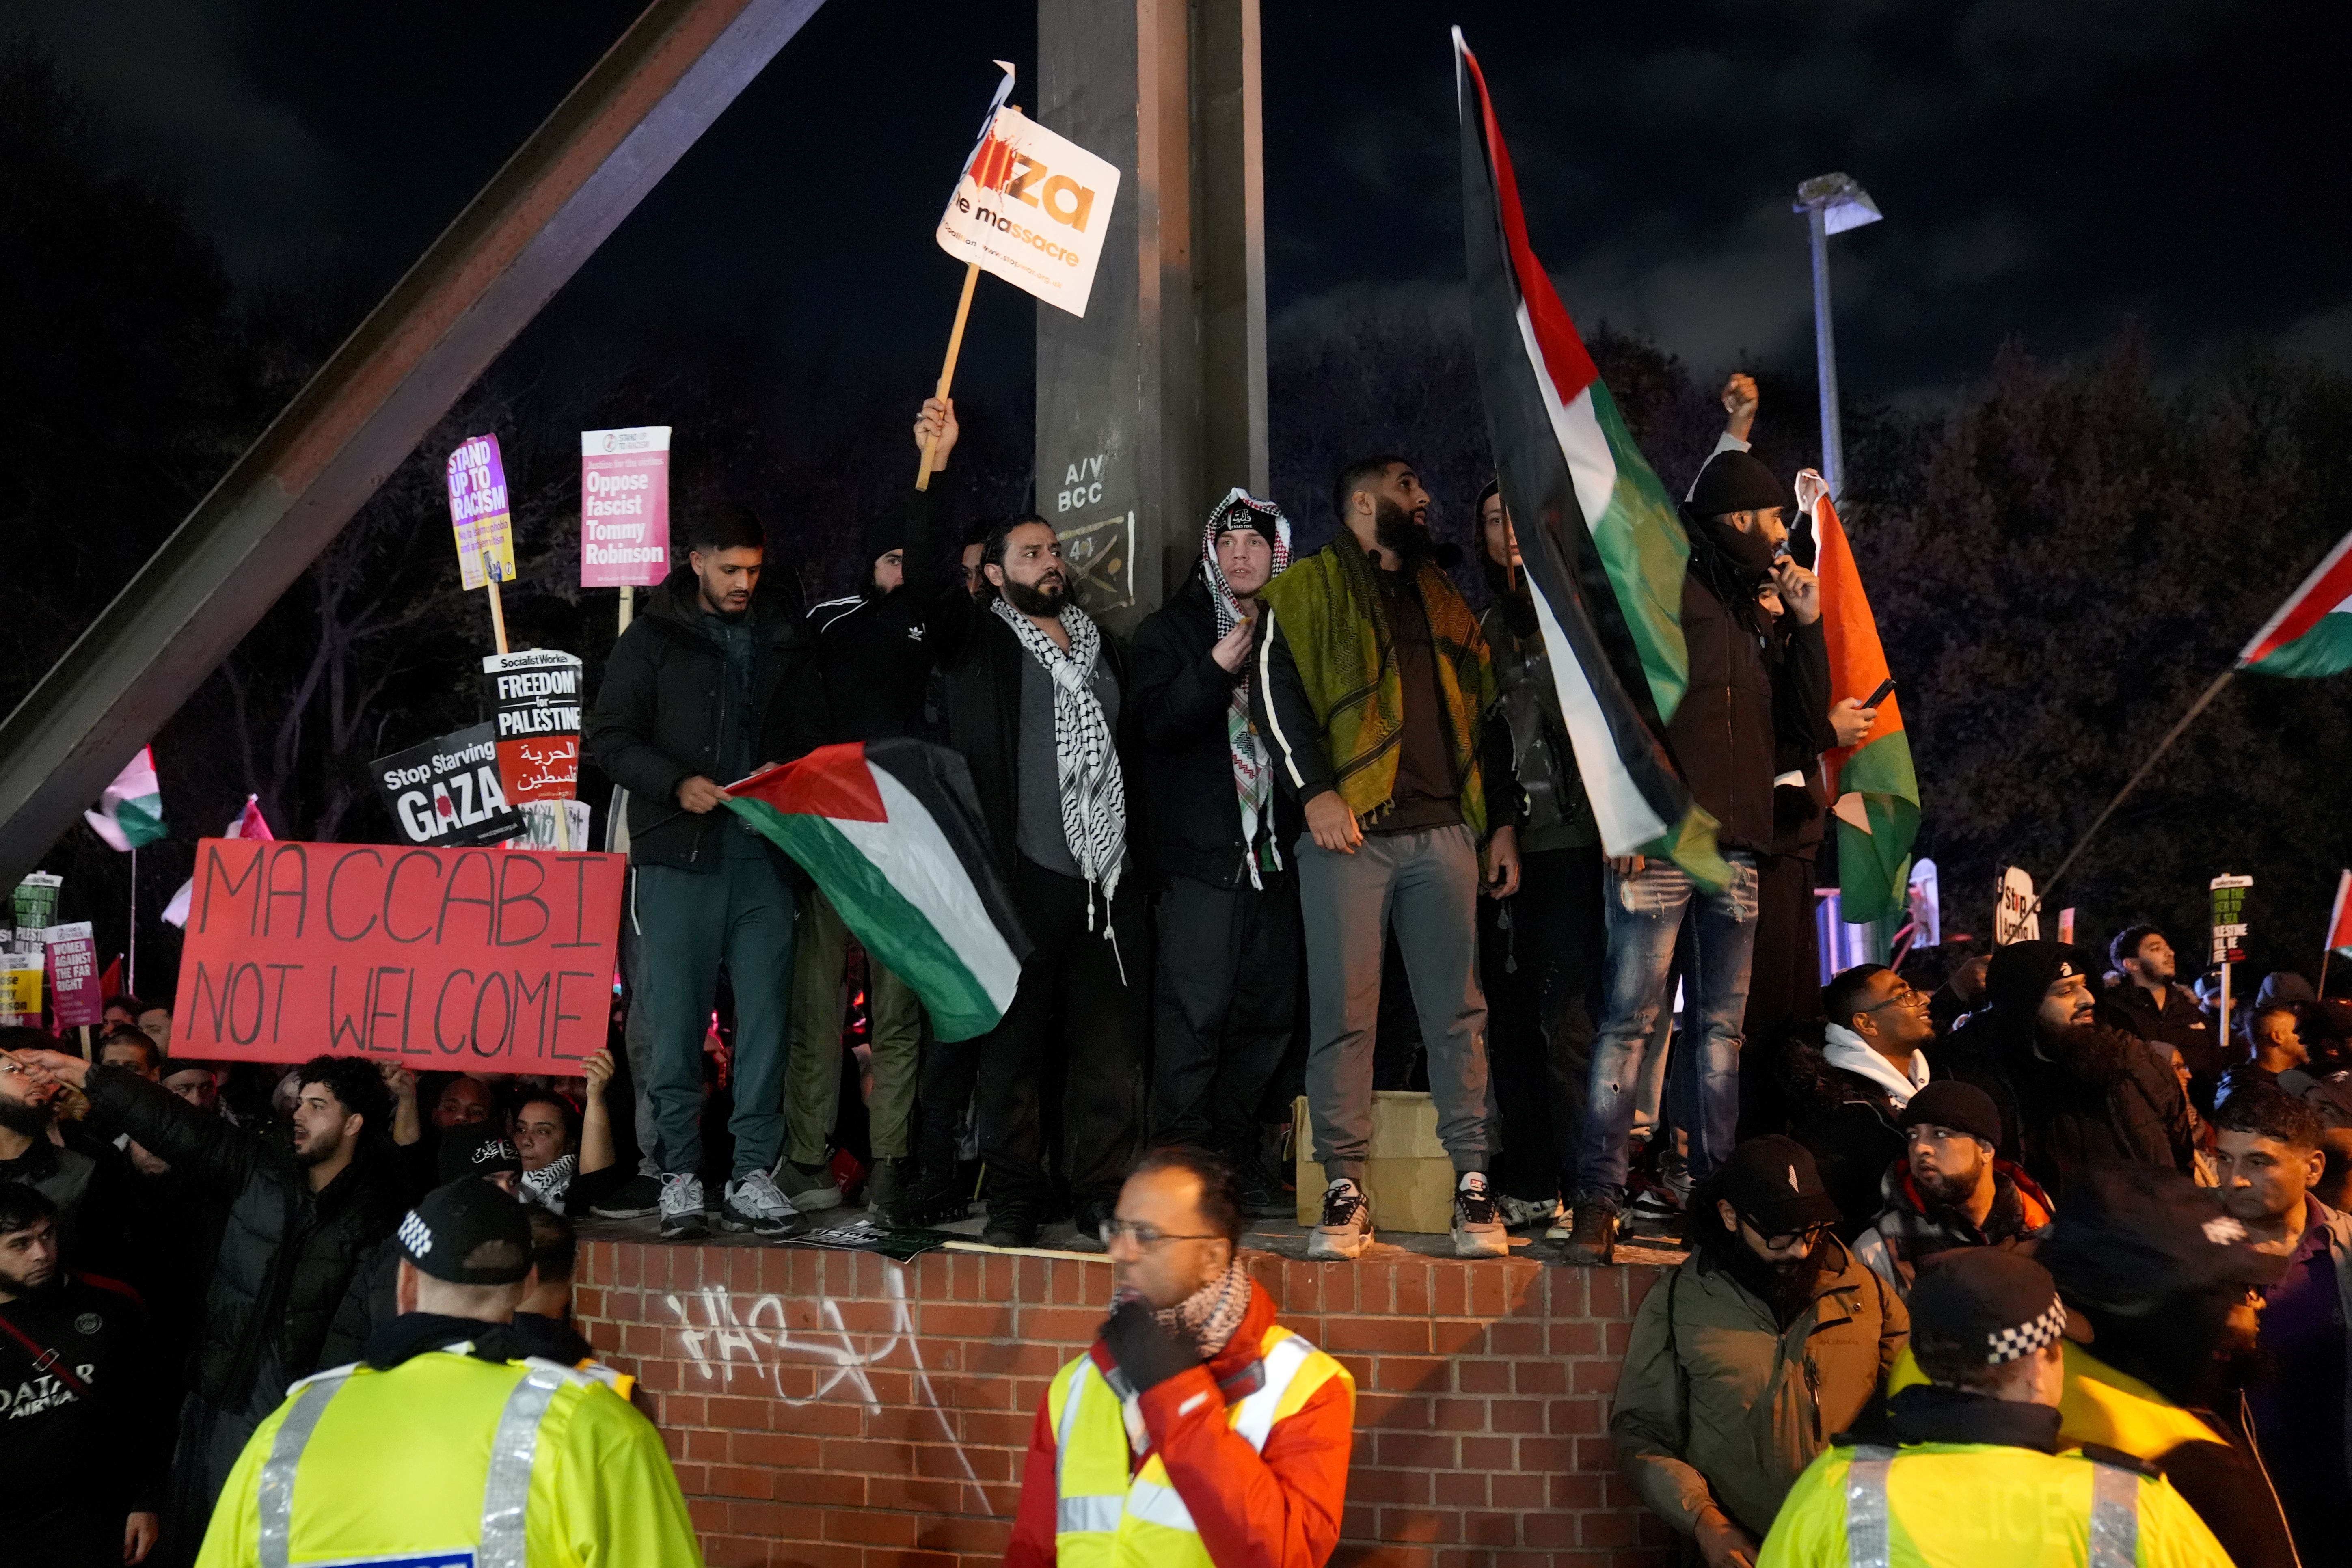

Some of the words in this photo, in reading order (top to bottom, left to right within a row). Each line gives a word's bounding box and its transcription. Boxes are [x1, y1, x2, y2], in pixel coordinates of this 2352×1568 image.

[975, 206, 1080, 268] massacre
[449, 441, 491, 475] STAND
[1065, 454, 1104, 486] A/V
[449, 471, 469, 498] UP
[468, 465, 491, 491] TO
[586, 471, 650, 497] Oppose
[453, 484, 506, 521] RACISM
[586, 494, 643, 517] fascist
[1058, 482, 1103, 512] BCC
[585, 519, 647, 544] Tommy
[585, 542, 665, 565] Robinson
[501, 655, 539, 669] Socialist
[538, 653, 568, 665] Worke
[497, 670, 576, 700] FREEDOM
[536, 695, 549, 708] for
[497, 706, 581, 736] PALESTINE
[384, 764, 432, 790] Stop
[431, 741, 496, 775] Starving
[520, 741, 575, 765] الحرية
[397, 765, 513, 842] GAZA
[199, 843, 608, 949] MACCABI
[54, 952, 91, 968] AGAINST
[55, 966, 72, 980] THE
[73, 964, 91, 978] FAR
[56, 977, 83, 992] RIGHT
[186, 960, 304, 1045] NOT
[329, 965, 596, 1061] WELCOME
